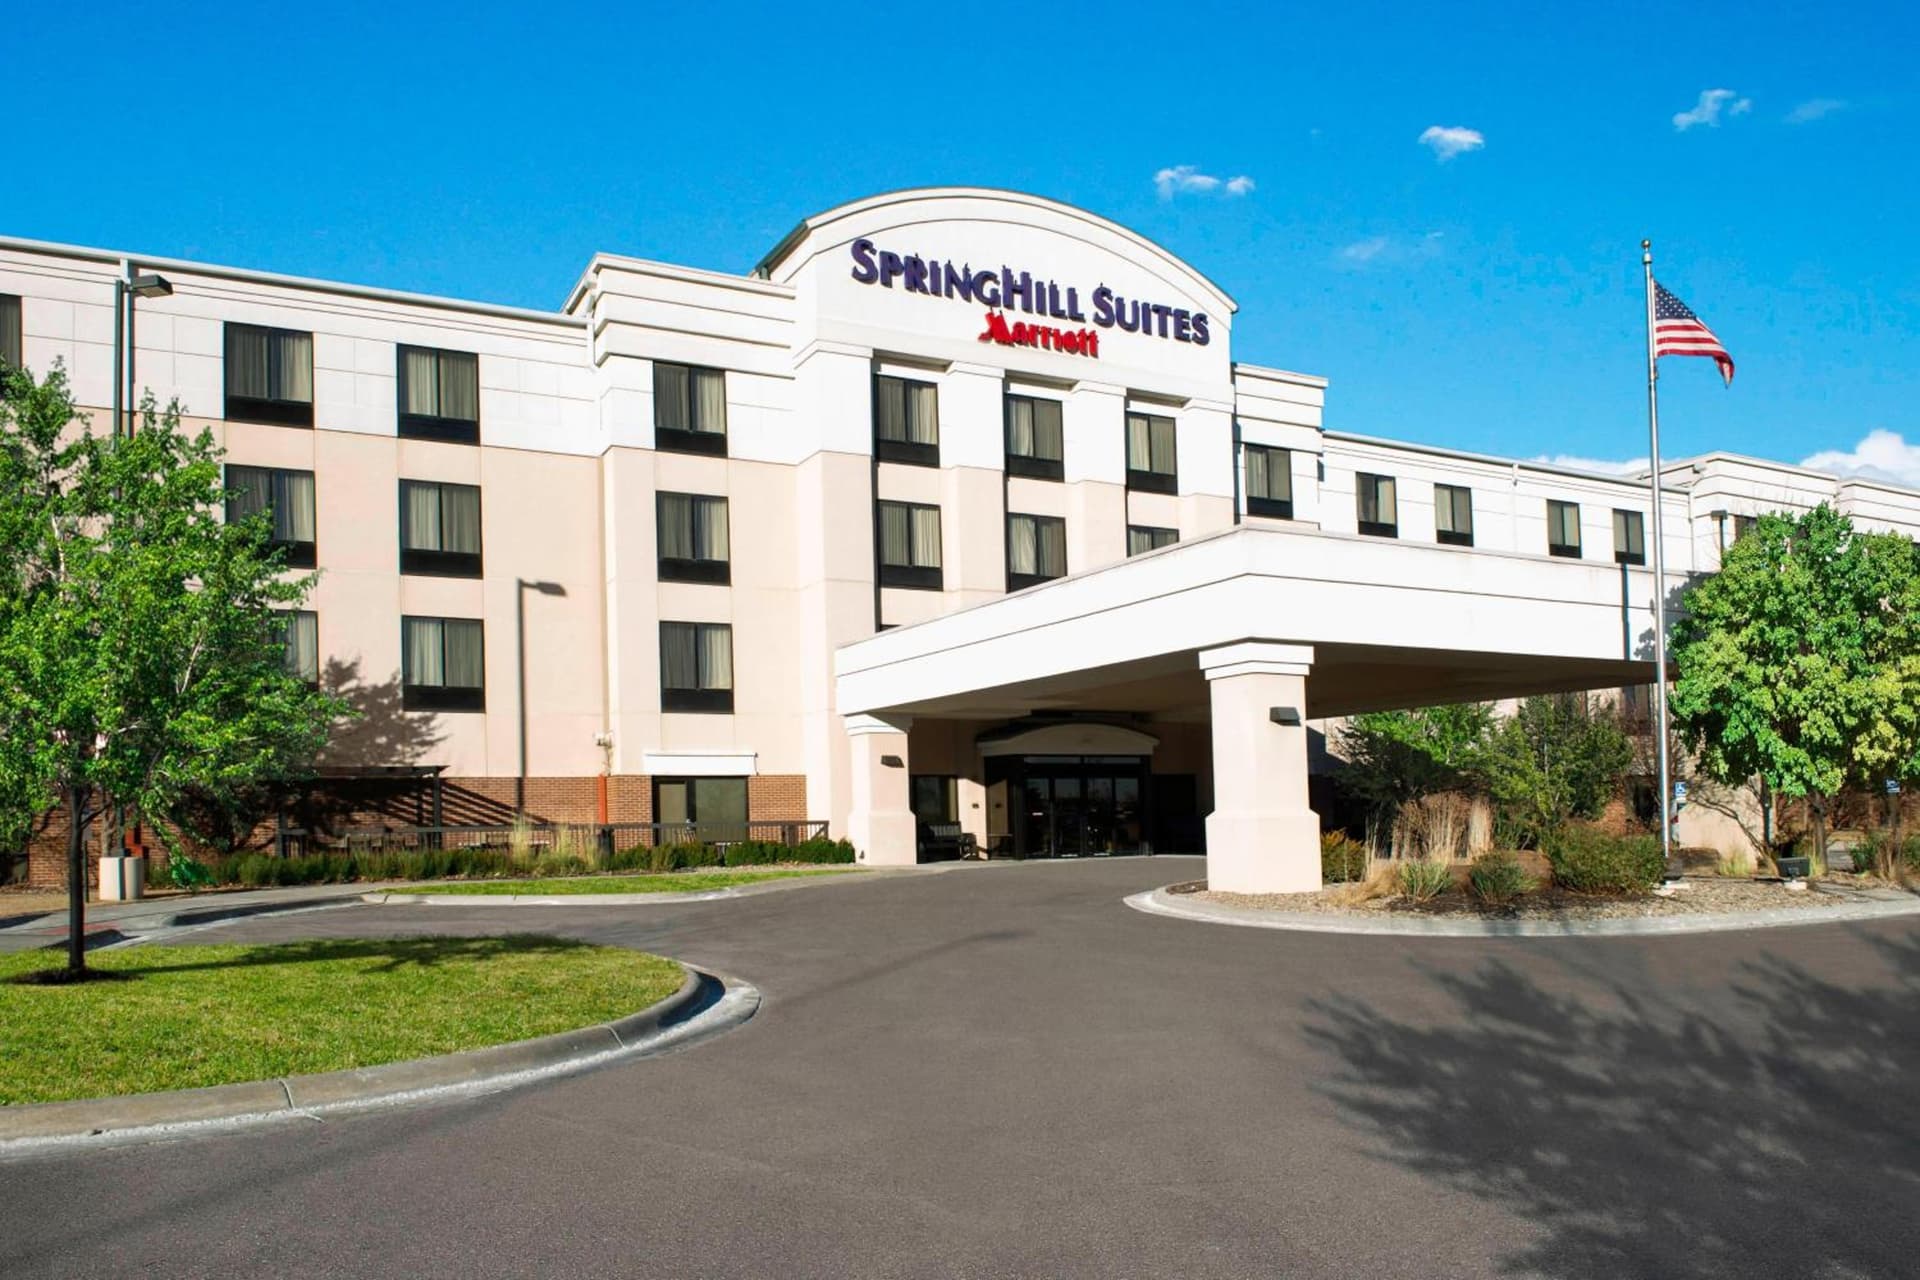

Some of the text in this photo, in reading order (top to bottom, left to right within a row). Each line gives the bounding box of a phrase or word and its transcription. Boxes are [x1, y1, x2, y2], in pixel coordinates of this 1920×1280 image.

[851, 238, 1210, 346] SPRINGHILL SUITES
[978, 310, 1099, 358] Marriott
